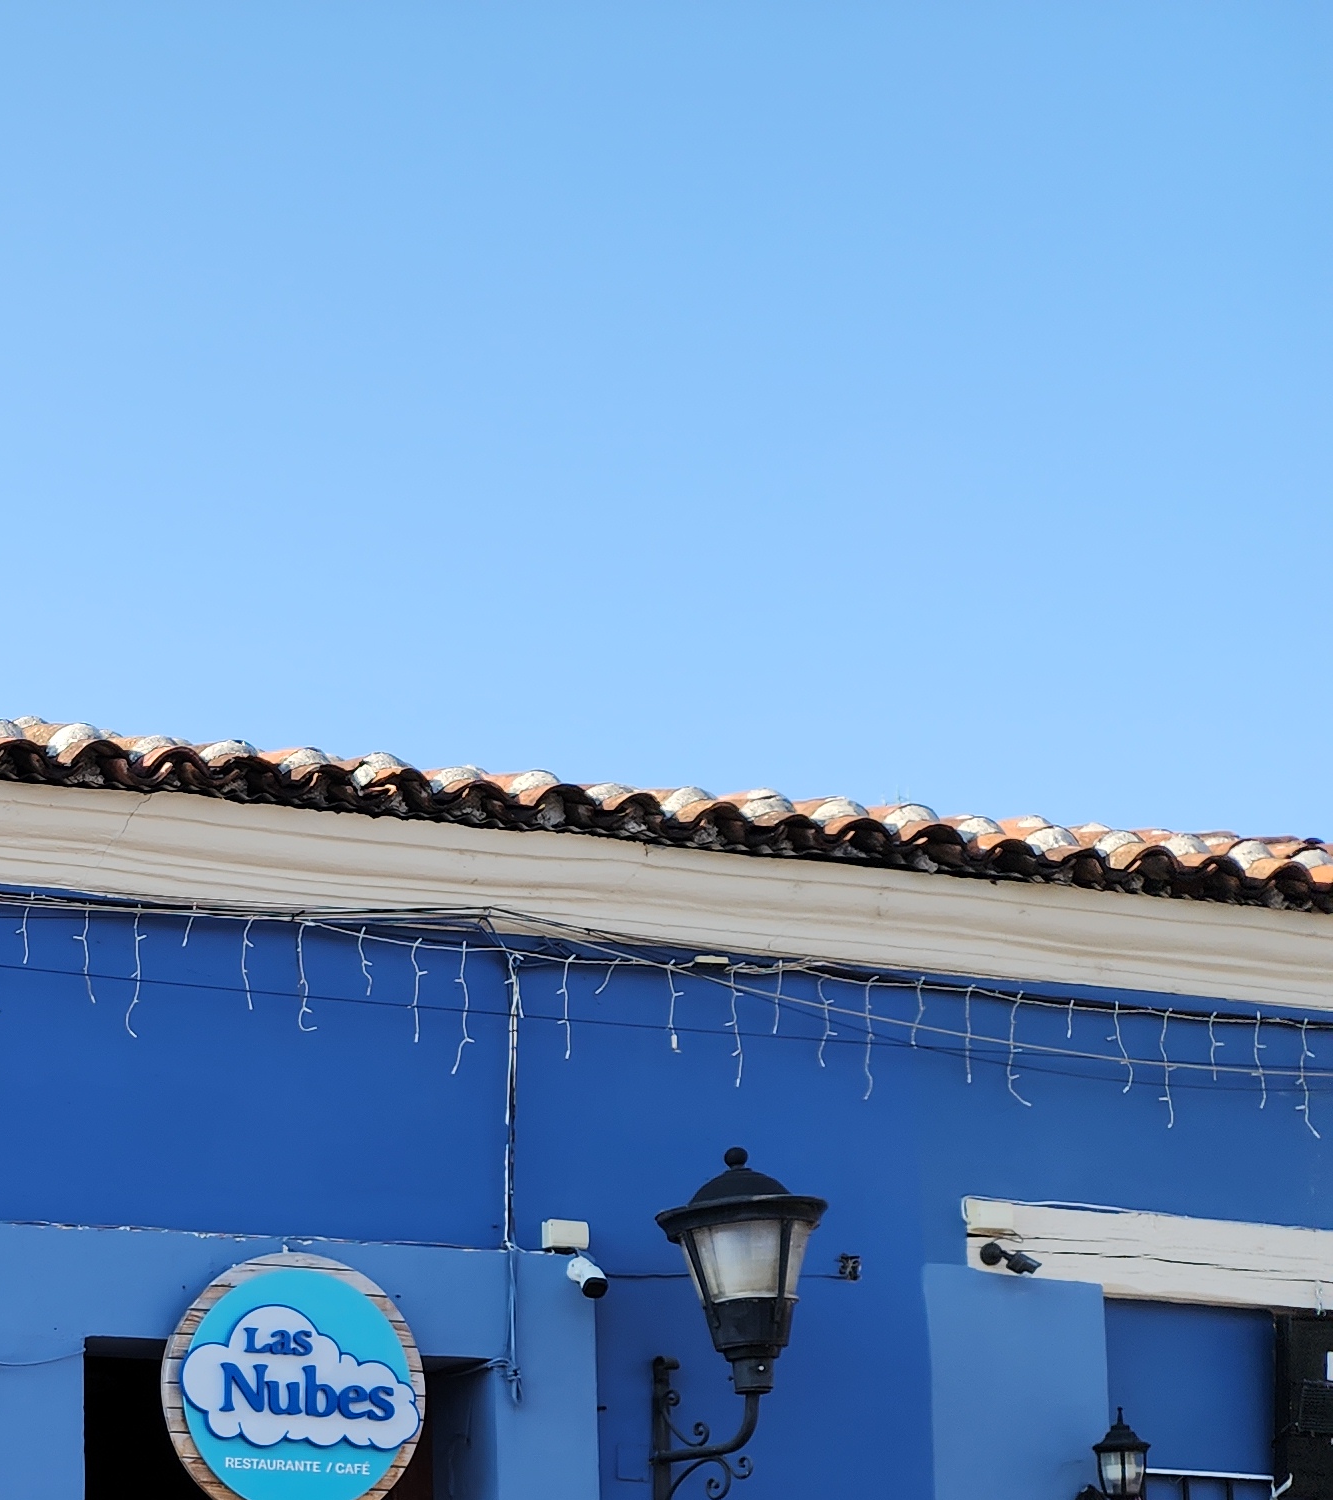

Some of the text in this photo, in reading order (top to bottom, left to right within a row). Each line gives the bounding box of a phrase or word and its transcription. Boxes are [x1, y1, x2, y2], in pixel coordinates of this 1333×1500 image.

[243, 1327, 314, 1356] Las
[219, 1362, 396, 1422] Nubes
[225, 1456, 321, 1473] RESTAURANTE
[335, 1461, 371, 1475] CAFÉ
